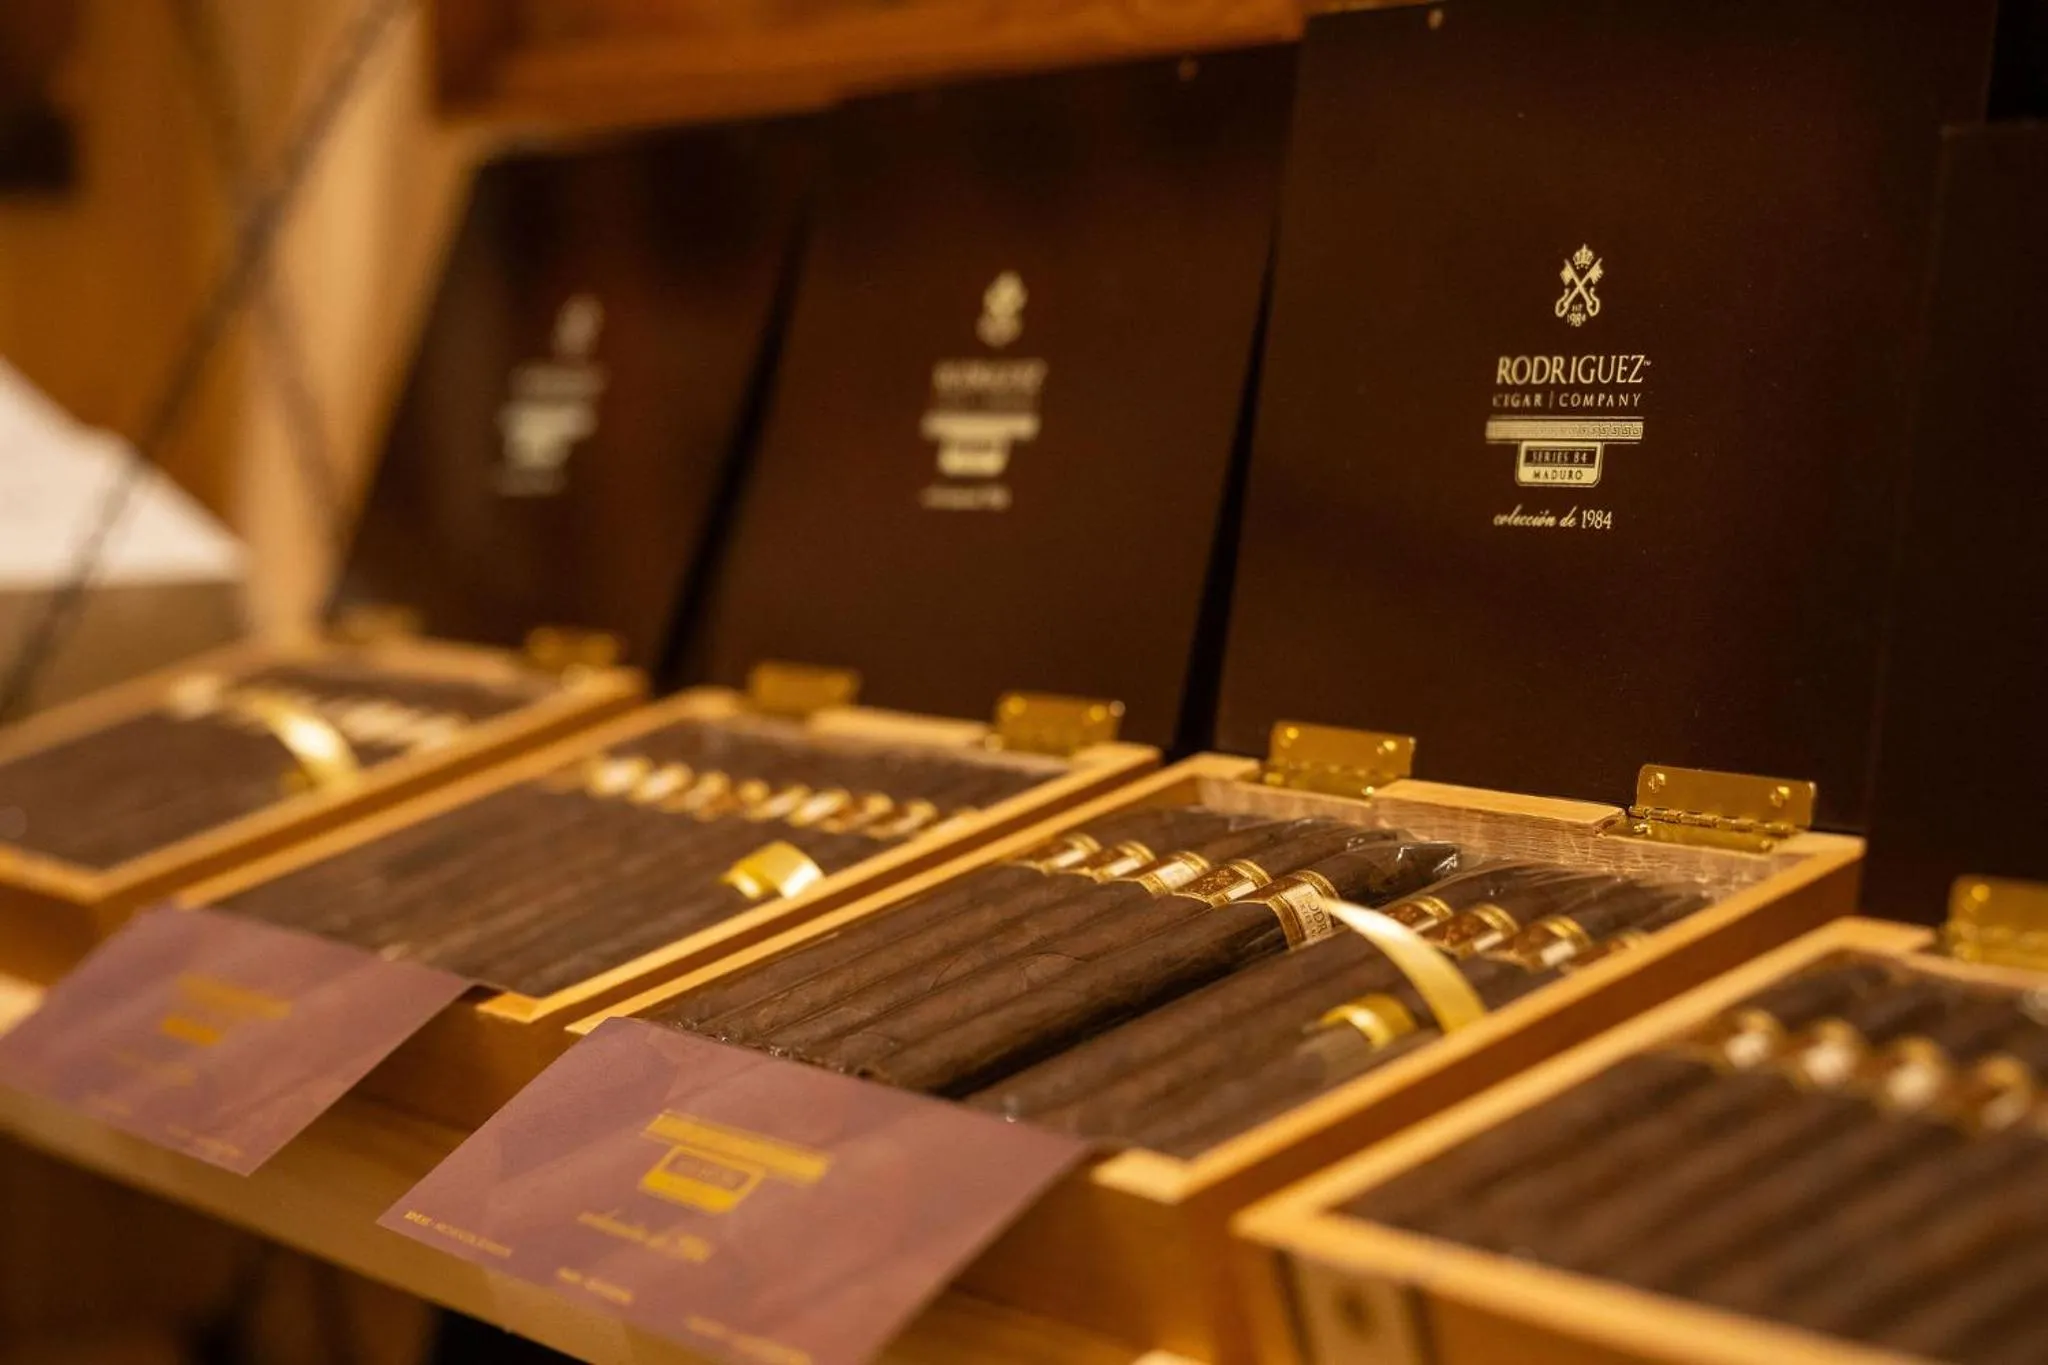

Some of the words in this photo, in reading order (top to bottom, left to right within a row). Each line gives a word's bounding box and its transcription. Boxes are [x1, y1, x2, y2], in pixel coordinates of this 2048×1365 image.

[1492, 393, 1542, 407] CIGAR
[1559, 393, 1640, 407] COMPANY
[1532, 452, 1569, 463] SERIES
[1574, 452, 1588, 463] 84
[1533, 470, 1583, 480] MADURO
[1560, 505, 1578, 527] de
[1581, 510, 1612, 529] 1984
